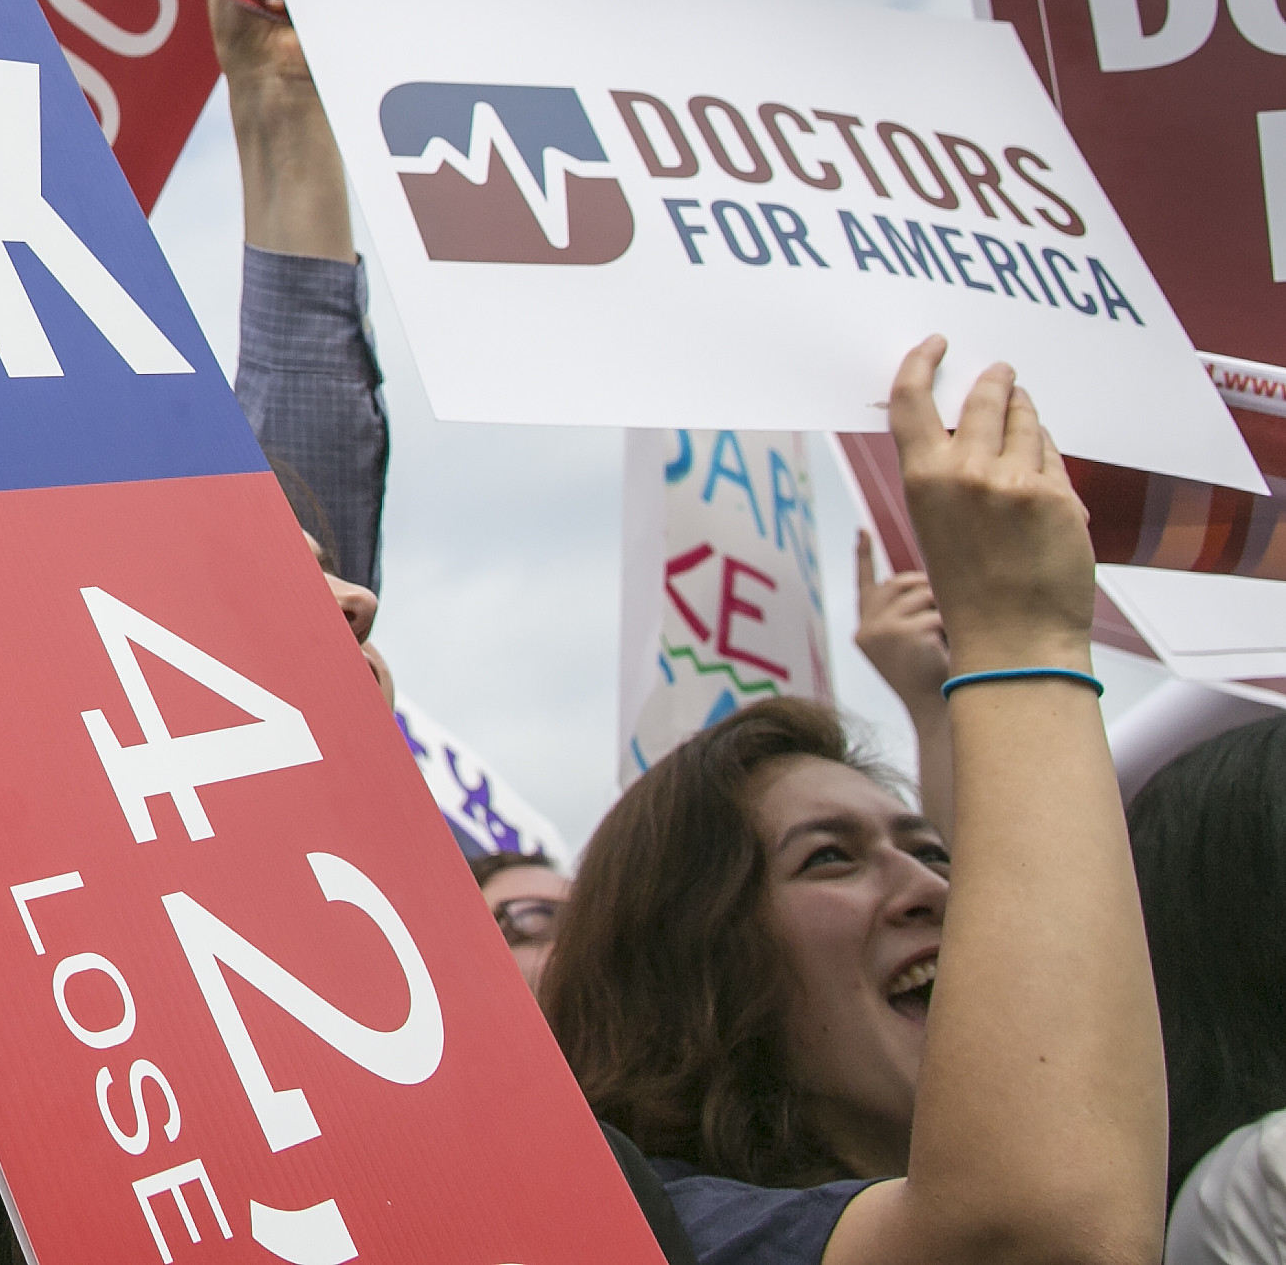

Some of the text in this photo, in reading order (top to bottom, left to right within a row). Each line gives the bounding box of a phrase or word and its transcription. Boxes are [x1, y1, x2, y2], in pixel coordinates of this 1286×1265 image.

[609, 89, 1087, 237] DOCTORS
[662, 198, 1147, 328] FOR AMERICA
[79, 586, 445, 1265] 42,
[10, 871, 233, 1265] LOSE
